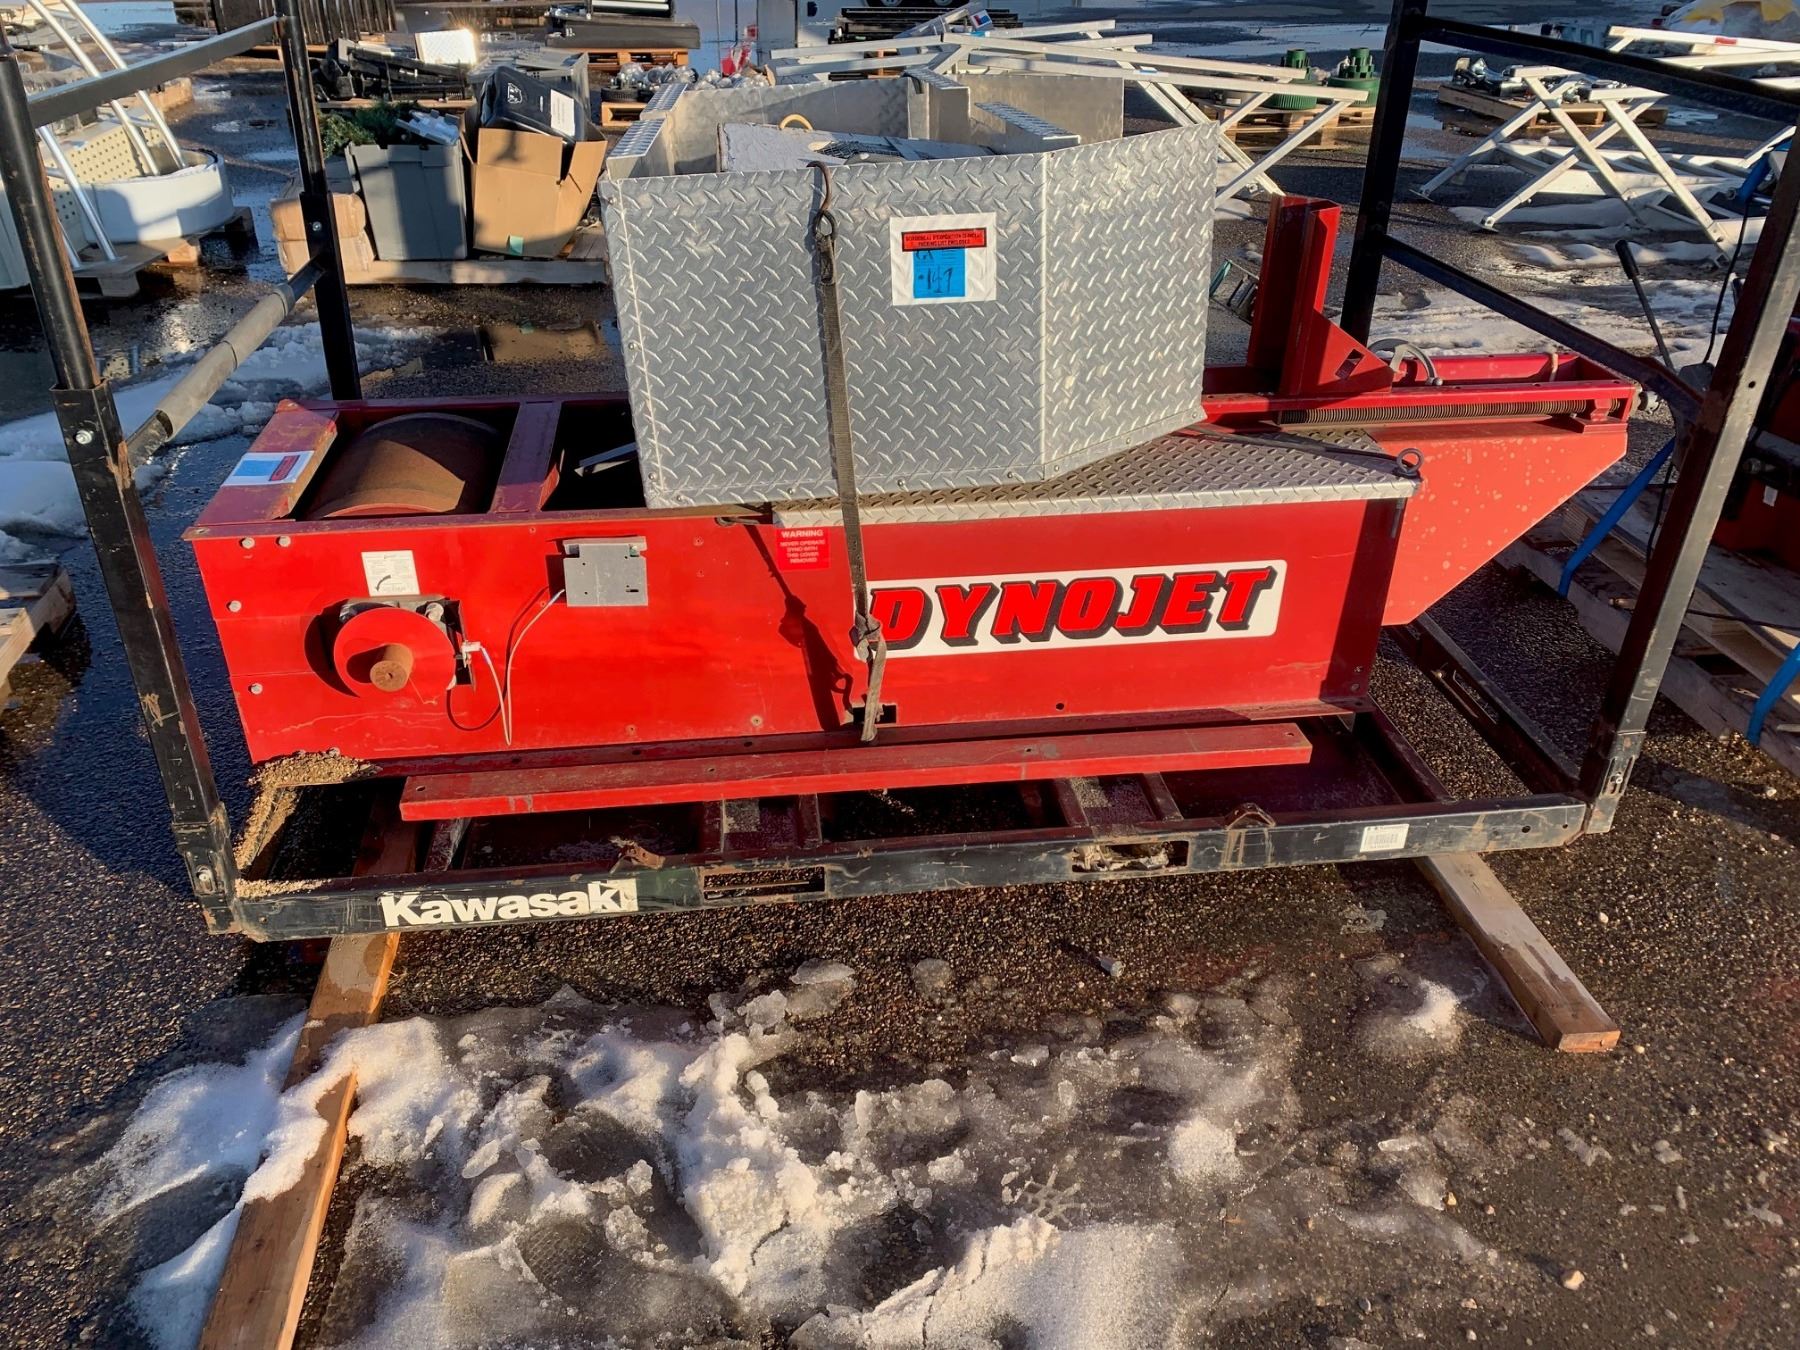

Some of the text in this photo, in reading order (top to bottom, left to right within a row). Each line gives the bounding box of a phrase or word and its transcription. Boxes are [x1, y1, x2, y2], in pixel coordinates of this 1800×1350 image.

[781, 529, 823, 538] WARNING
[868, 566, 1277, 651] DYNOJET
[378, 879, 639, 928] Kawasaki
